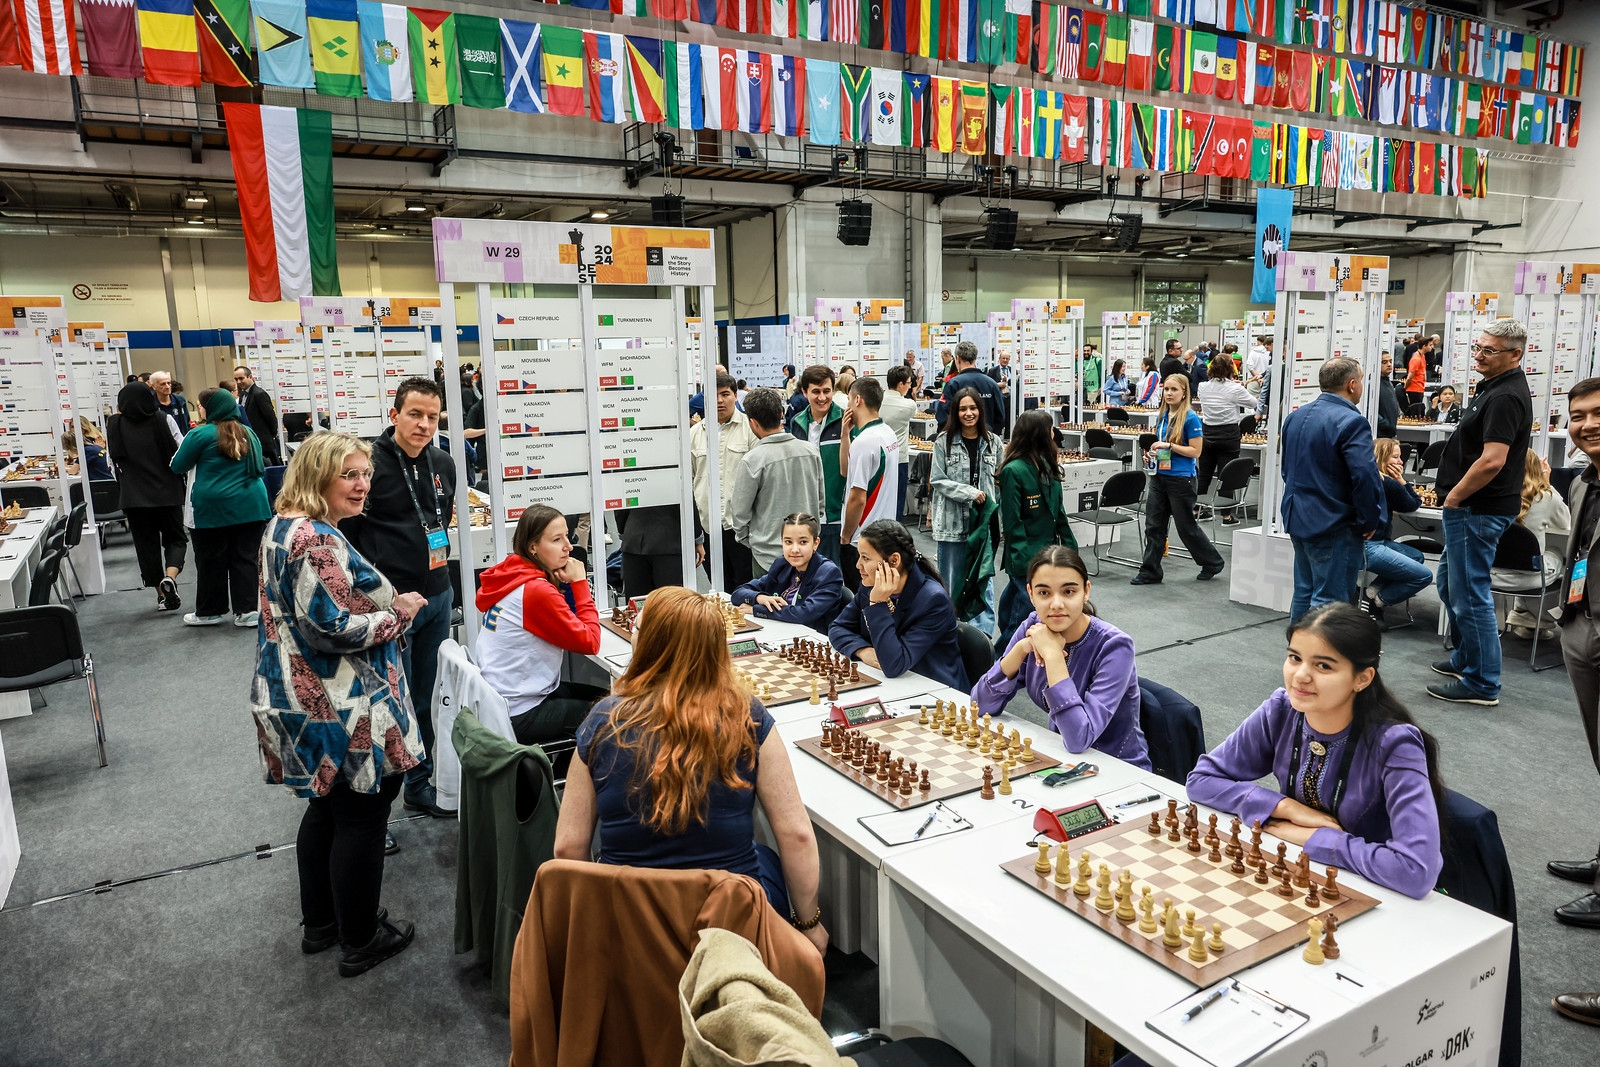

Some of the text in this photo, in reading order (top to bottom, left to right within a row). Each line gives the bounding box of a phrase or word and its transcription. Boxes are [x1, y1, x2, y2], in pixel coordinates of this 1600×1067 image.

[486, 246, 520, 258] W 29
[560, 245, 577, 254] BU
[594, 245, 612, 254] 20
[560, 255, 577, 263] DA
[595, 256, 613, 265] 24
[1012, 799, 1034, 809] 2
[1336, 972, 1364, 987] 1
